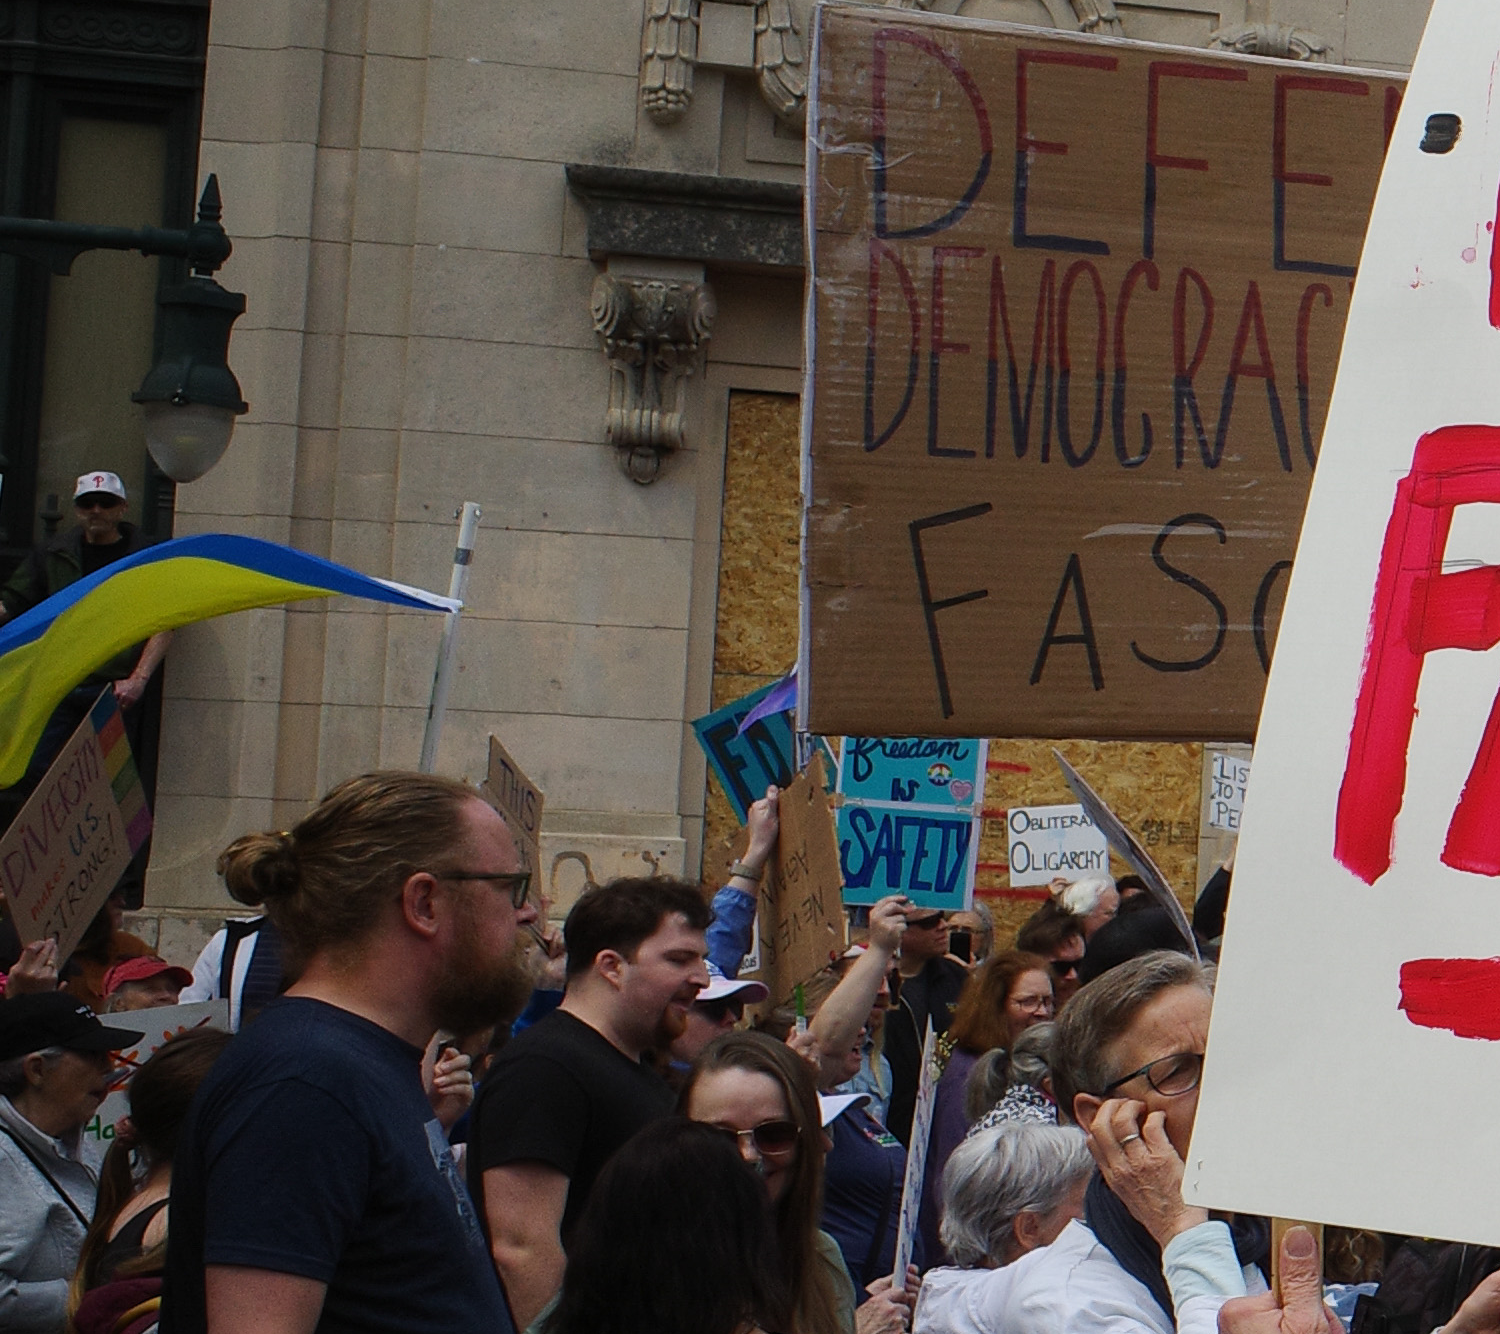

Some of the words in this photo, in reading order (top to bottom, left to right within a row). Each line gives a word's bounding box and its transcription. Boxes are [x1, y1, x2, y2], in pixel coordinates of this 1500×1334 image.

[872, 27, 1404, 278] DEFE
[863, 237, 1357, 473] DEMOCRAC
[500, 758, 536, 833] THIS
[1009, 809, 1093, 835] OBLITERA
[840, 807, 974, 894] SAFETY
